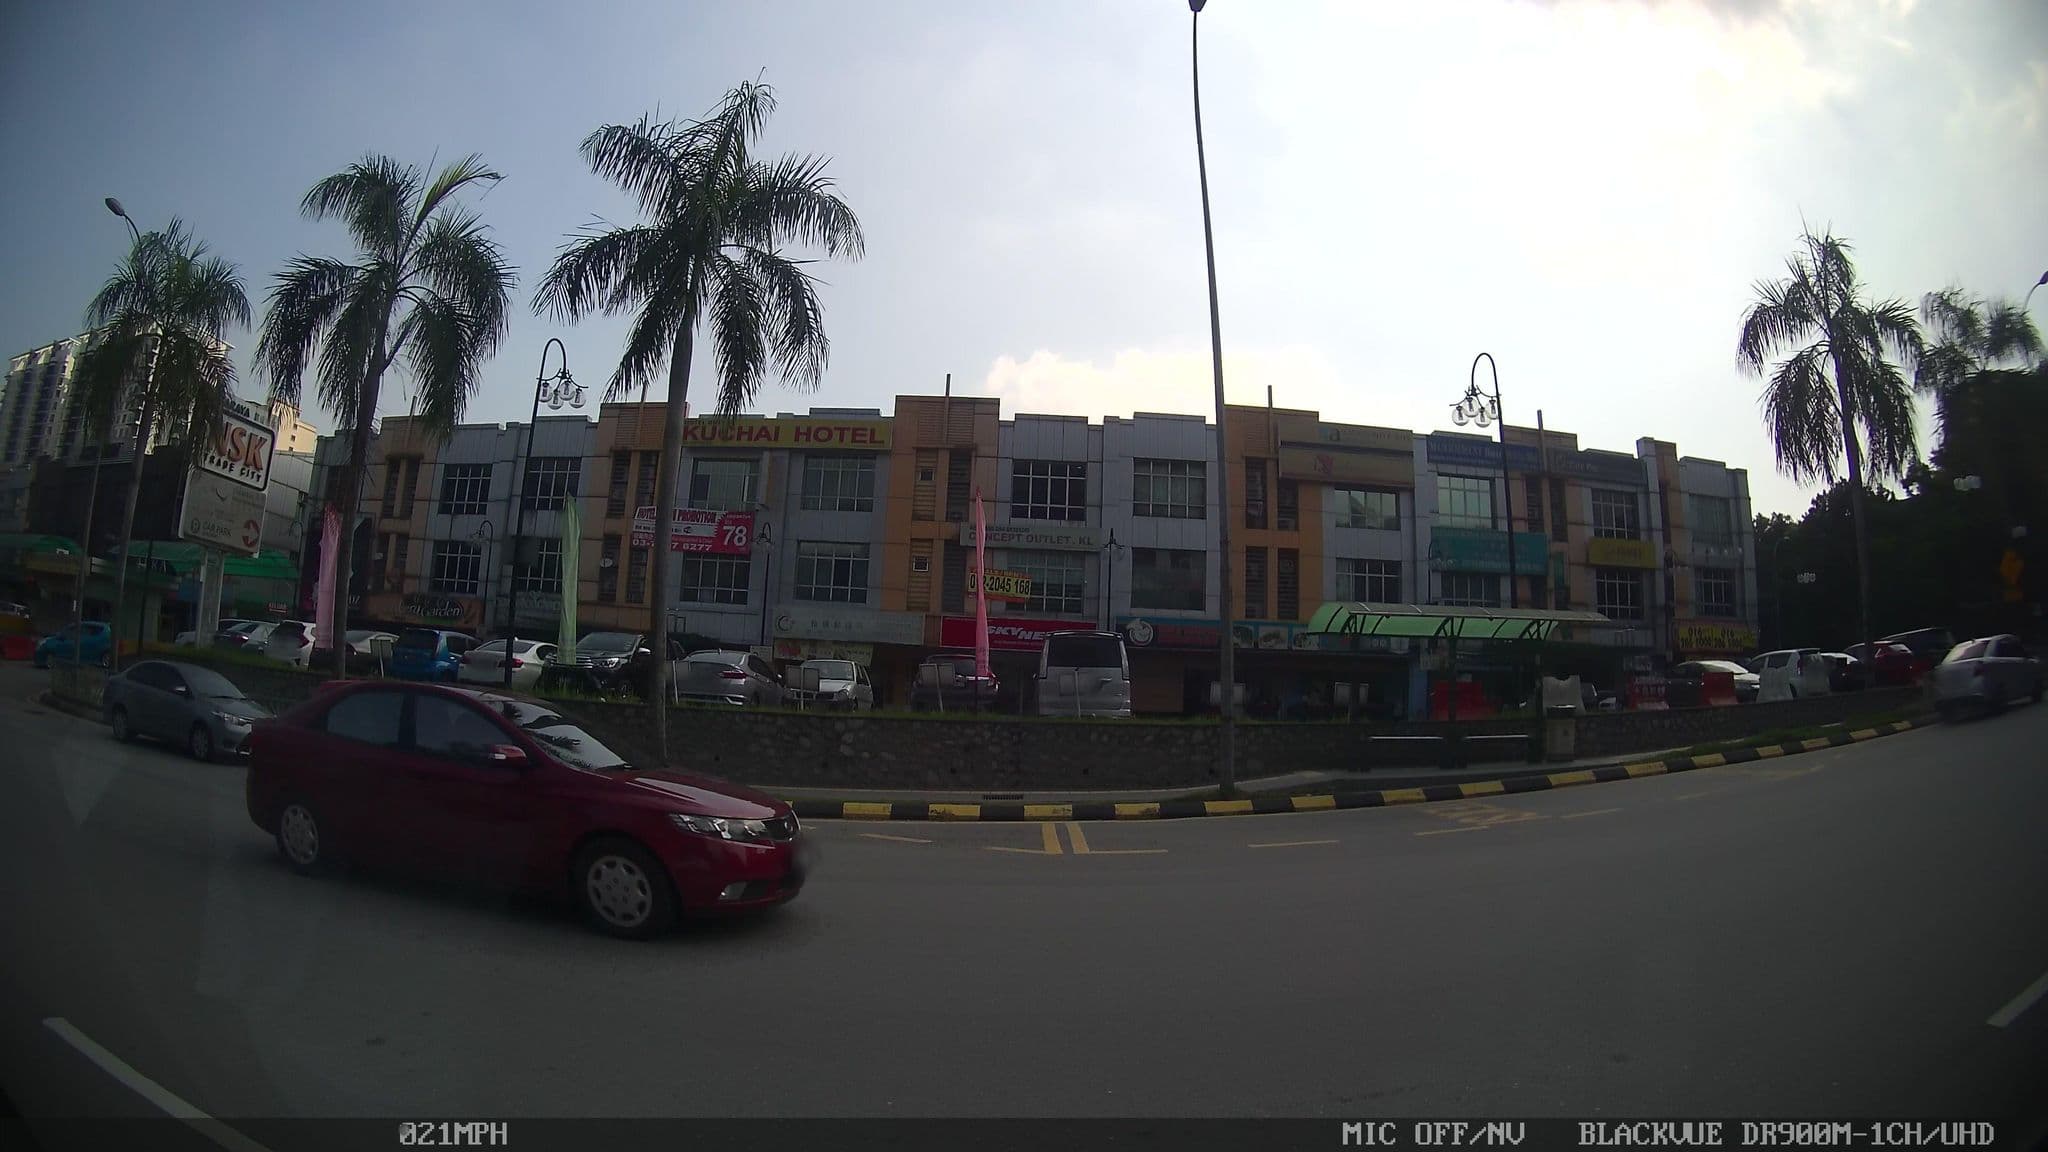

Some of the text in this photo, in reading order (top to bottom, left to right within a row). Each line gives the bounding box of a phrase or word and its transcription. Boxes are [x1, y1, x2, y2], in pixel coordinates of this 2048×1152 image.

[683, 425, 885, 444] KUCHAI HOTEL
[240, 467, 262, 483] CITY
[722, 524, 748, 547] 78
[968, 530, 1023, 542] CNCEPT
[969, 573, 1012, 593] 02-2045
[987, 625, 1050, 641] SKYNE
